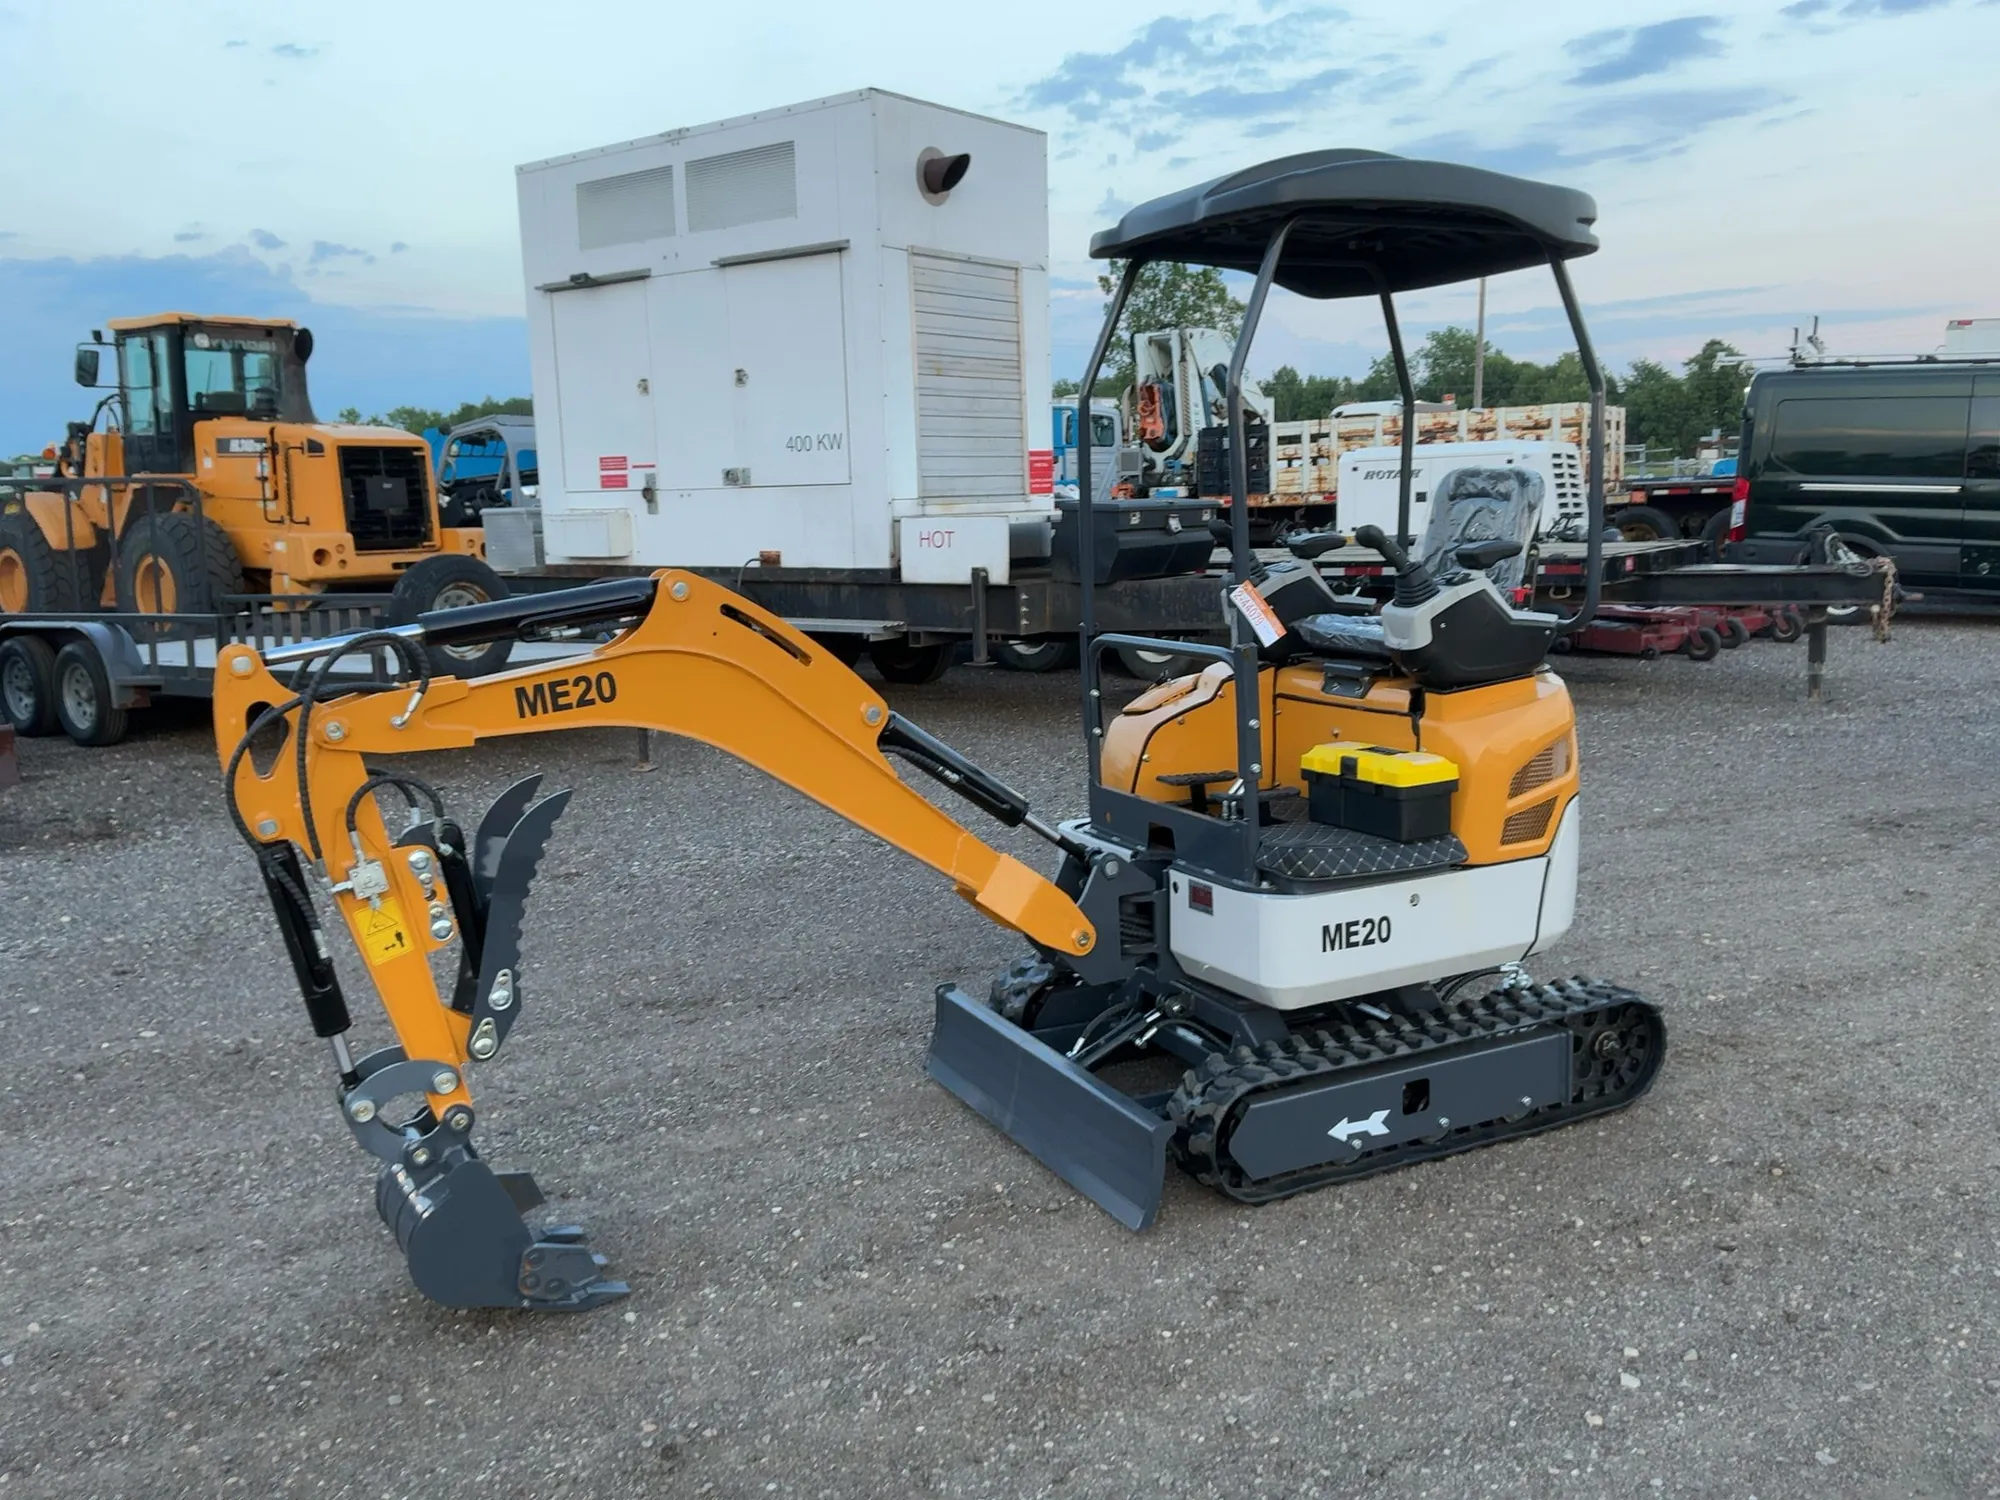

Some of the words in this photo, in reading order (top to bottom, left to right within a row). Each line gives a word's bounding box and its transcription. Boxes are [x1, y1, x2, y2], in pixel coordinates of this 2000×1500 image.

[785, 435, 813, 452] 400
[816, 432, 843, 451] KW
[1363, 468, 1424, 480] ROTAR
[919, 530, 955, 548] HOT
[514, 671, 617, 719] ME20
[1321, 915, 1391, 953] ME20
